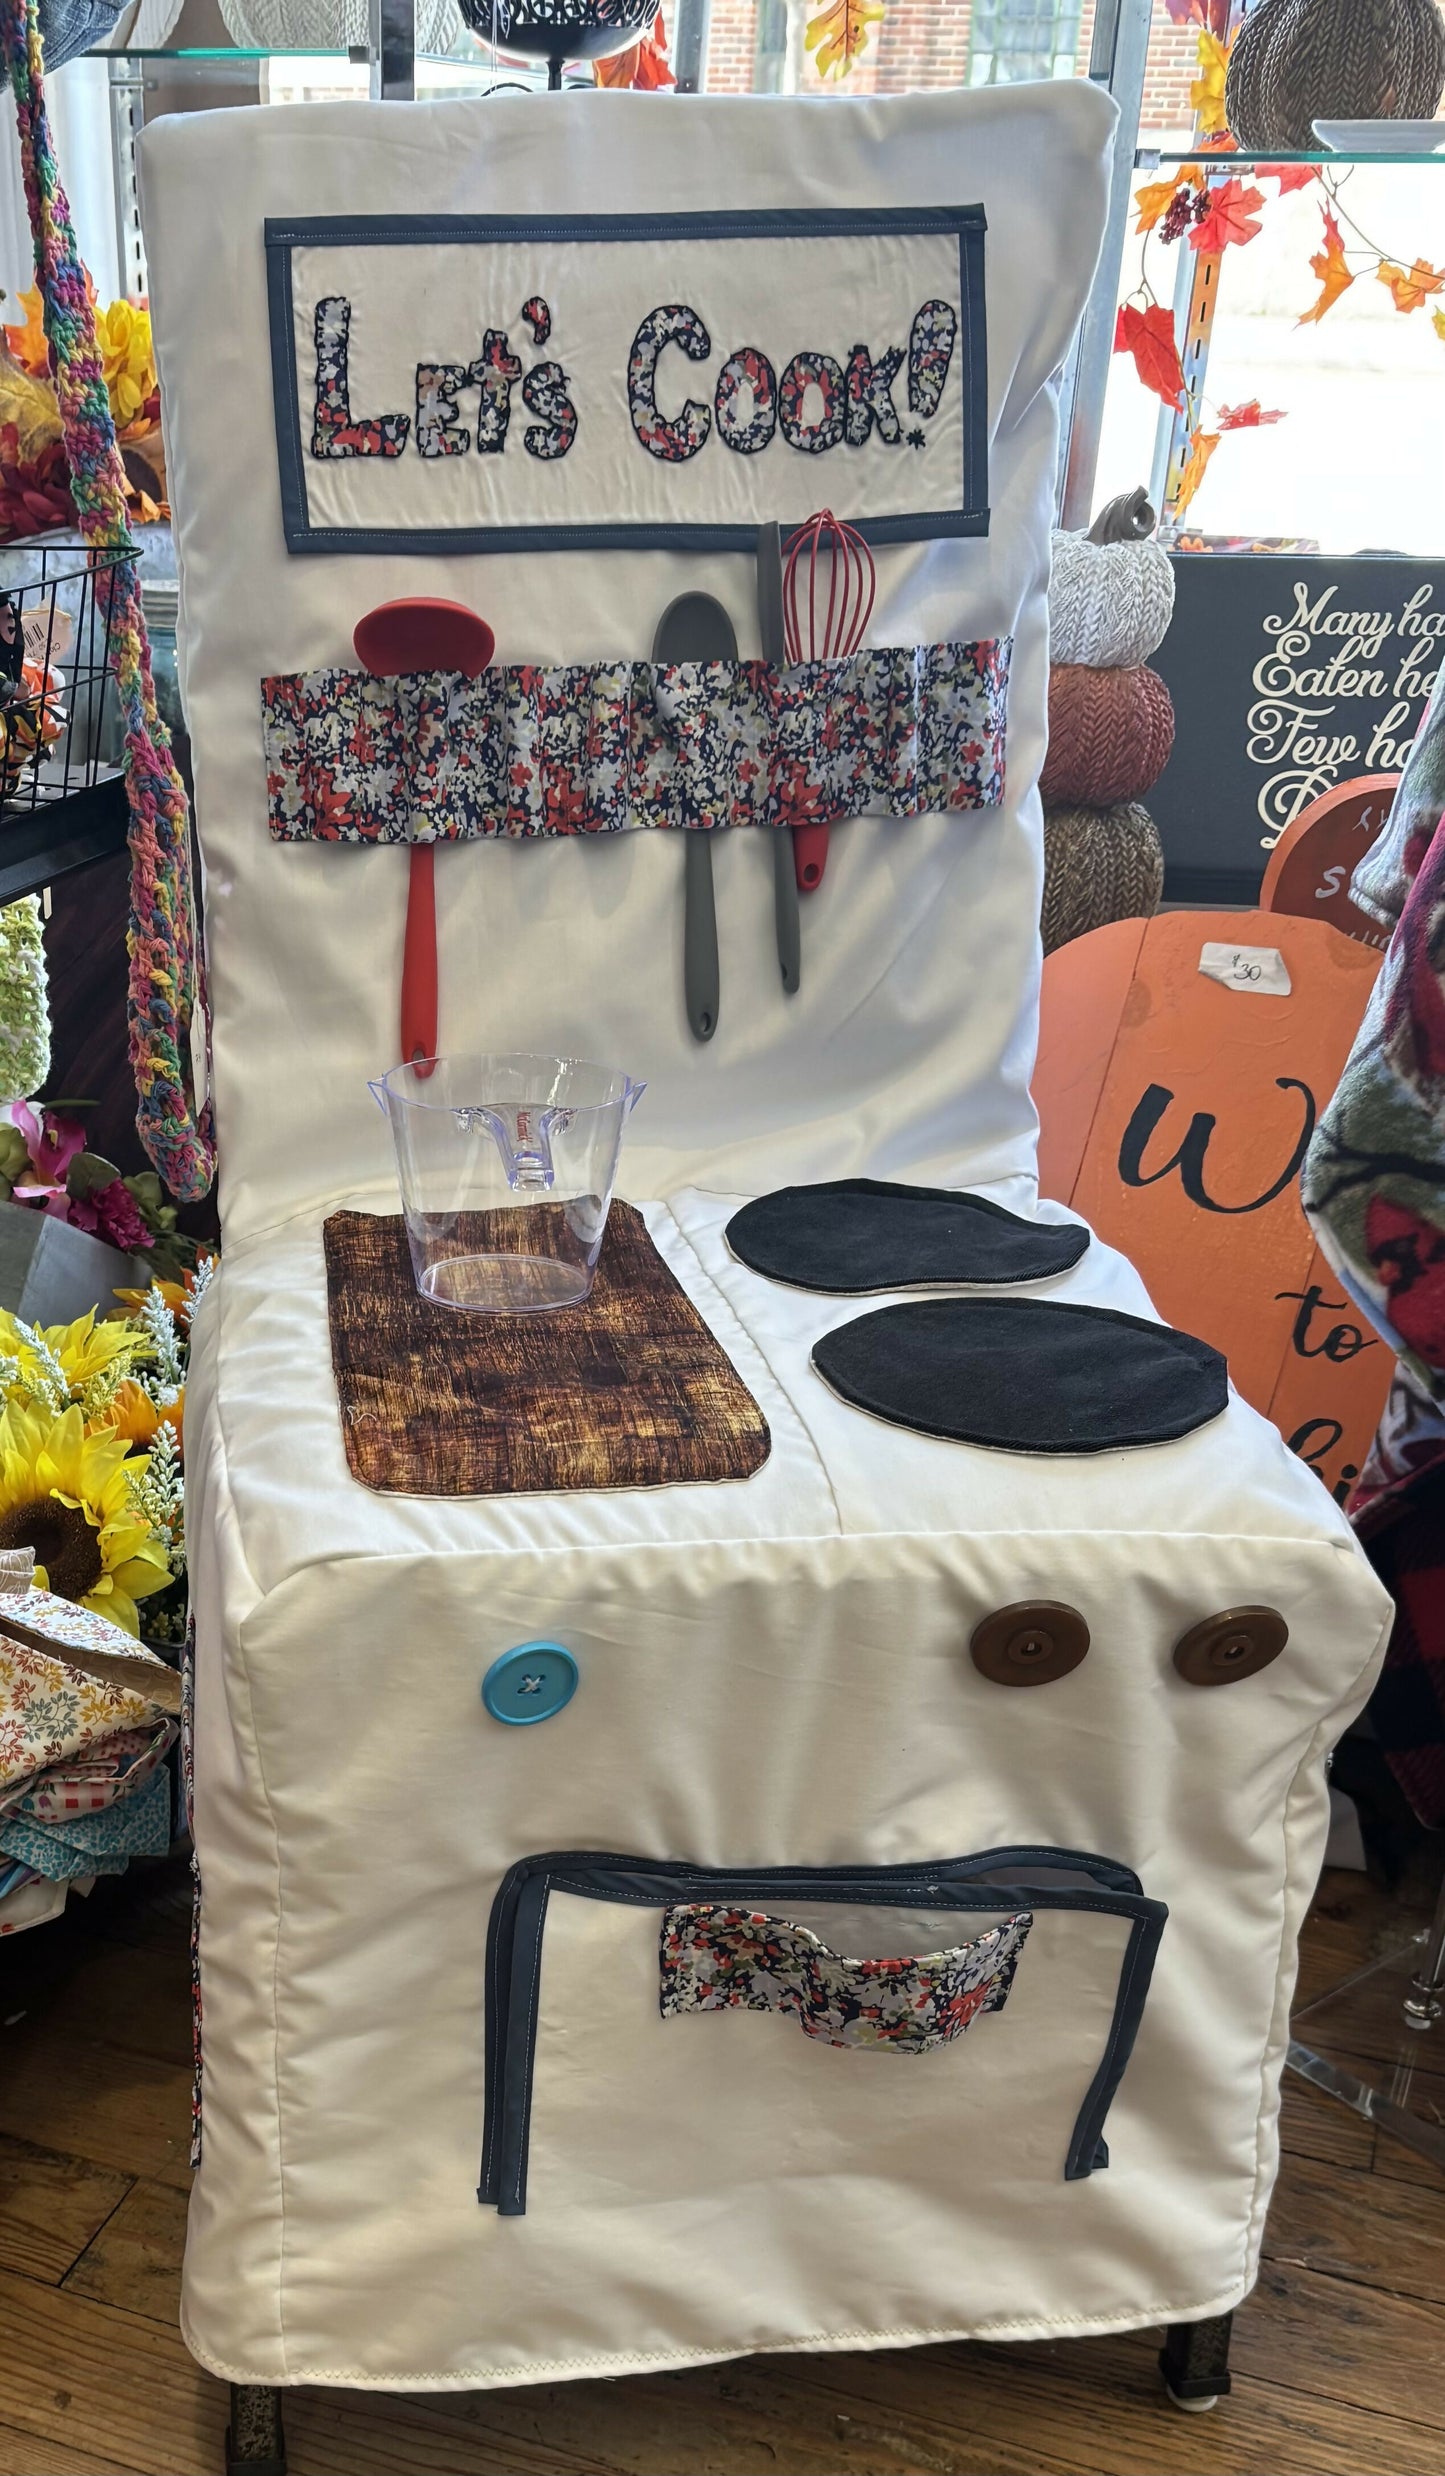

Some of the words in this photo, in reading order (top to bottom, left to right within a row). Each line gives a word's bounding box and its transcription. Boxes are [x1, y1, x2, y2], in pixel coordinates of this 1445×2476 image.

[628, 299, 957, 462] Cook!
[1263, 582, 1395, 659] Many
[1252, 630, 1388, 697] Eaten
[1247, 699, 1361, 765] Few
[1274, 1285, 1378, 1363] to
